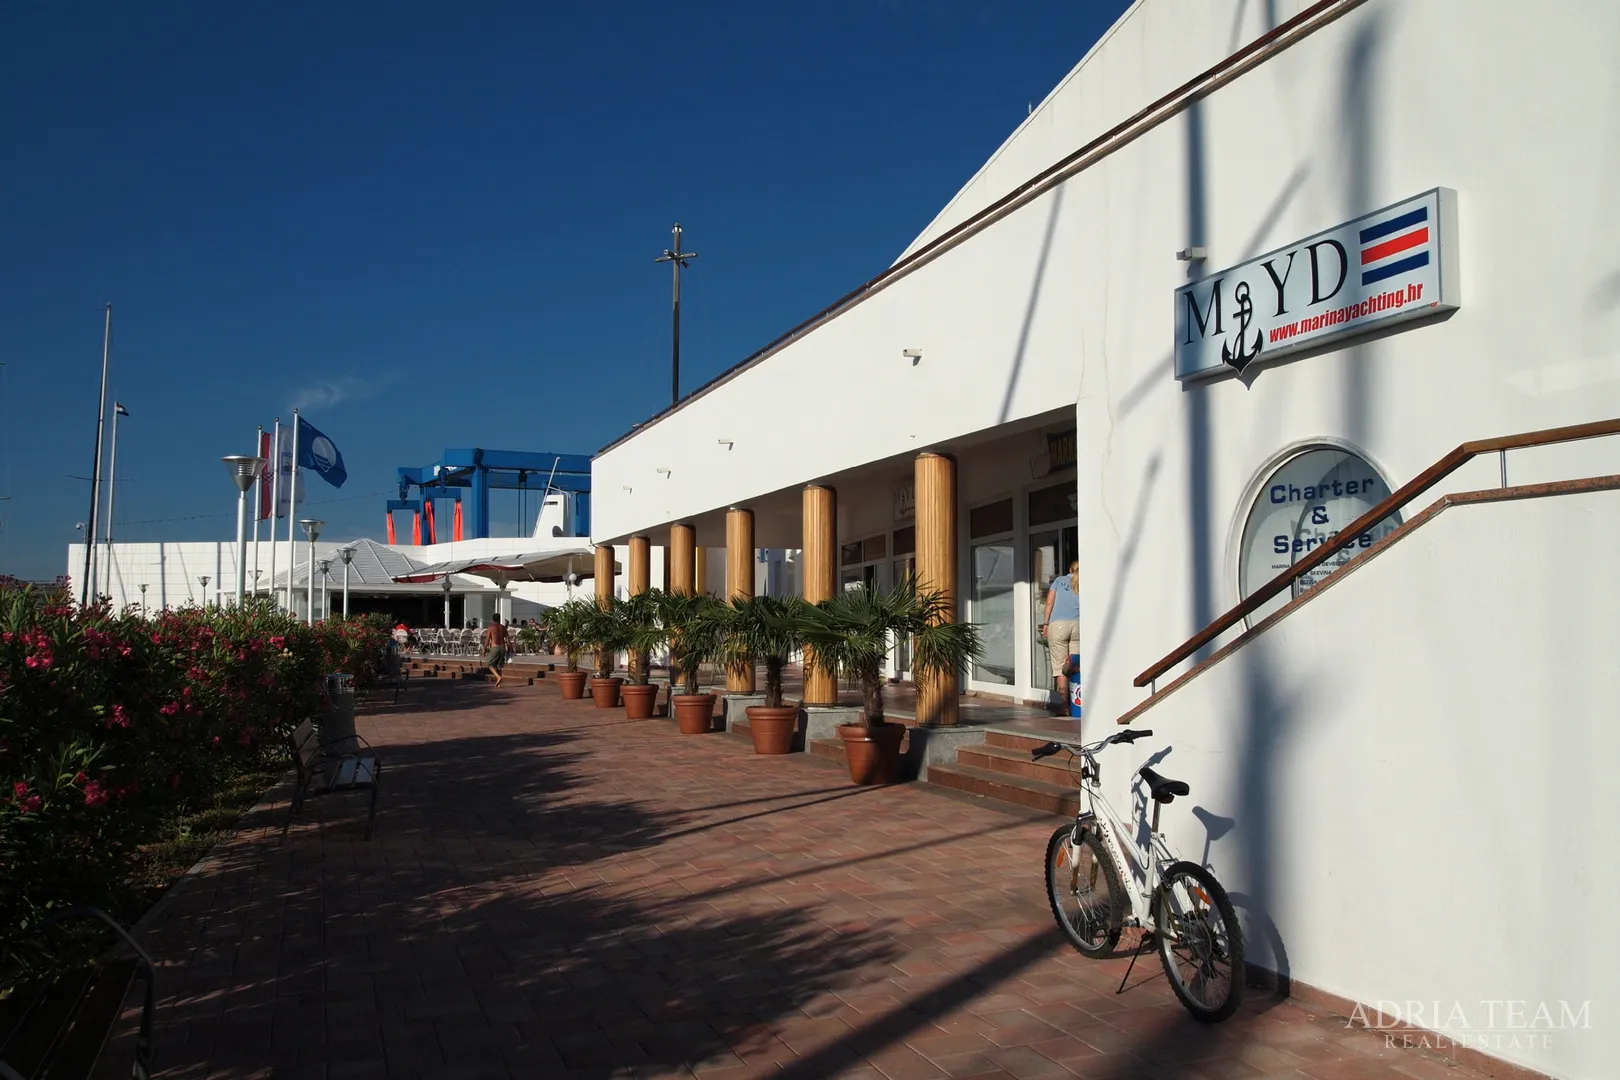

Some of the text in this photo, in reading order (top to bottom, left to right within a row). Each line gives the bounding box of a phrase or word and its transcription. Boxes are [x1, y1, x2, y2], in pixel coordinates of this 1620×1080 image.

[1269, 283, 1424, 344] www.marinayachting.hr
[1270, 477, 1374, 504] Charter
[1311, 505, 1330, 525] &
[1273, 533, 1372, 554] Servce
